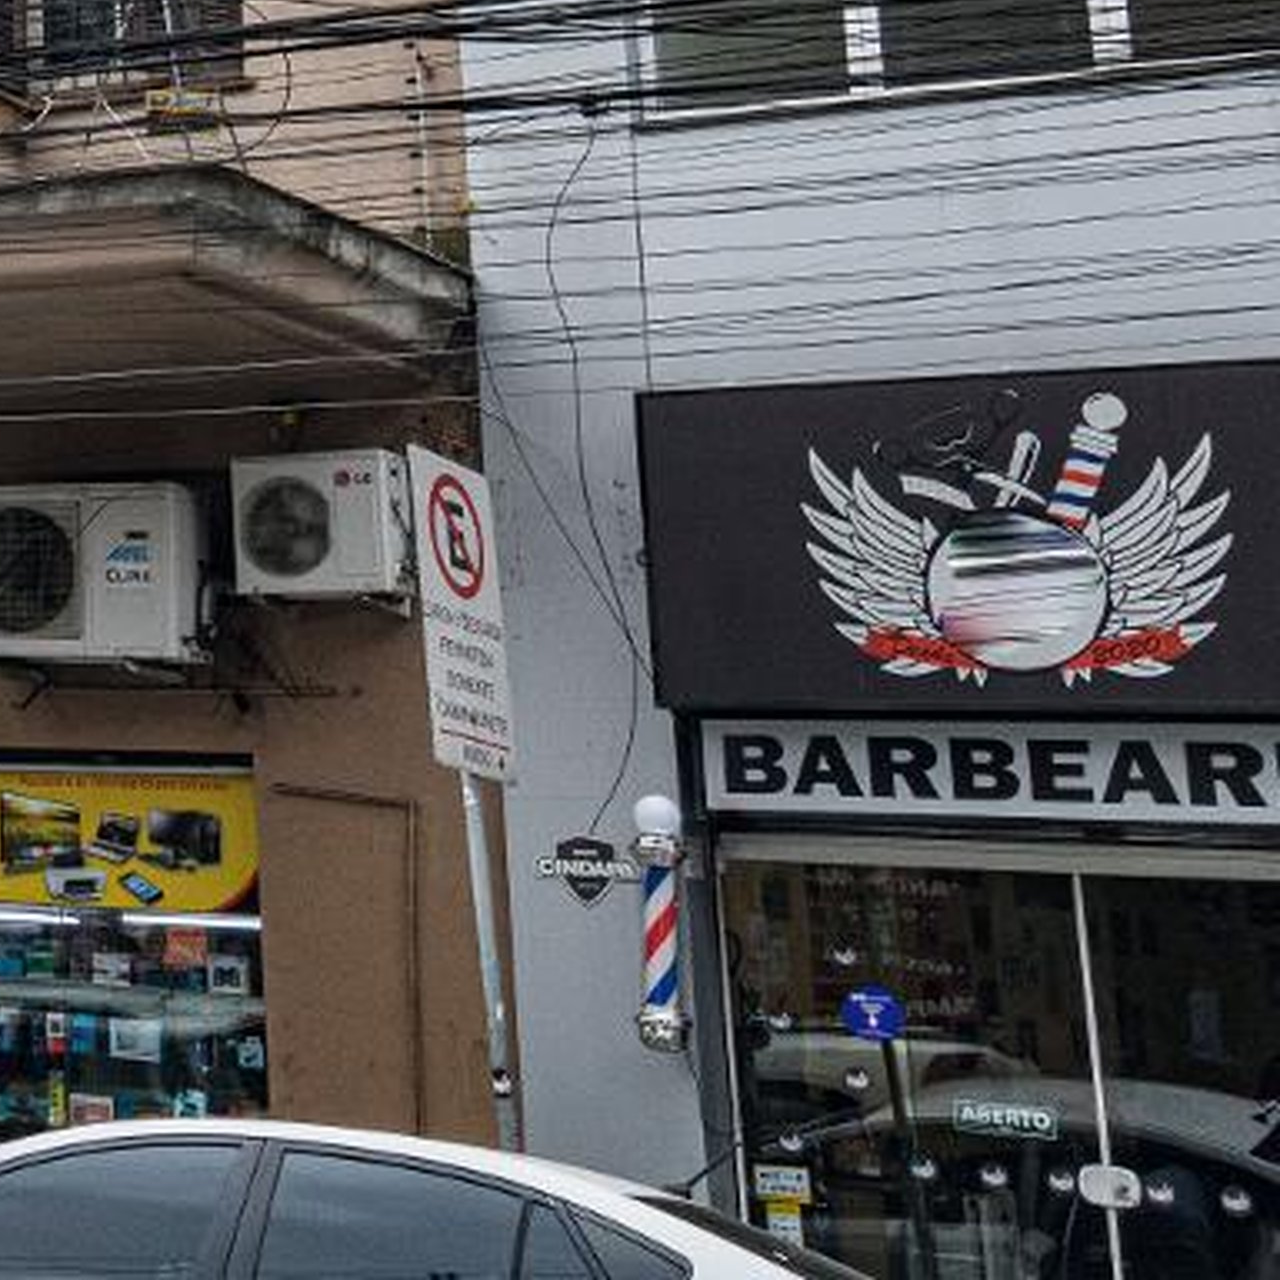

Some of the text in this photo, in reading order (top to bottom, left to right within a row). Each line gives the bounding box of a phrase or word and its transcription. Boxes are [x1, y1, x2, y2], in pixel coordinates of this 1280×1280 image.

[1088, 633, 1162, 665] 2020
[722, 733, 1280, 808] BARBEAR
[960, 1105, 1053, 1132] ABERTO
